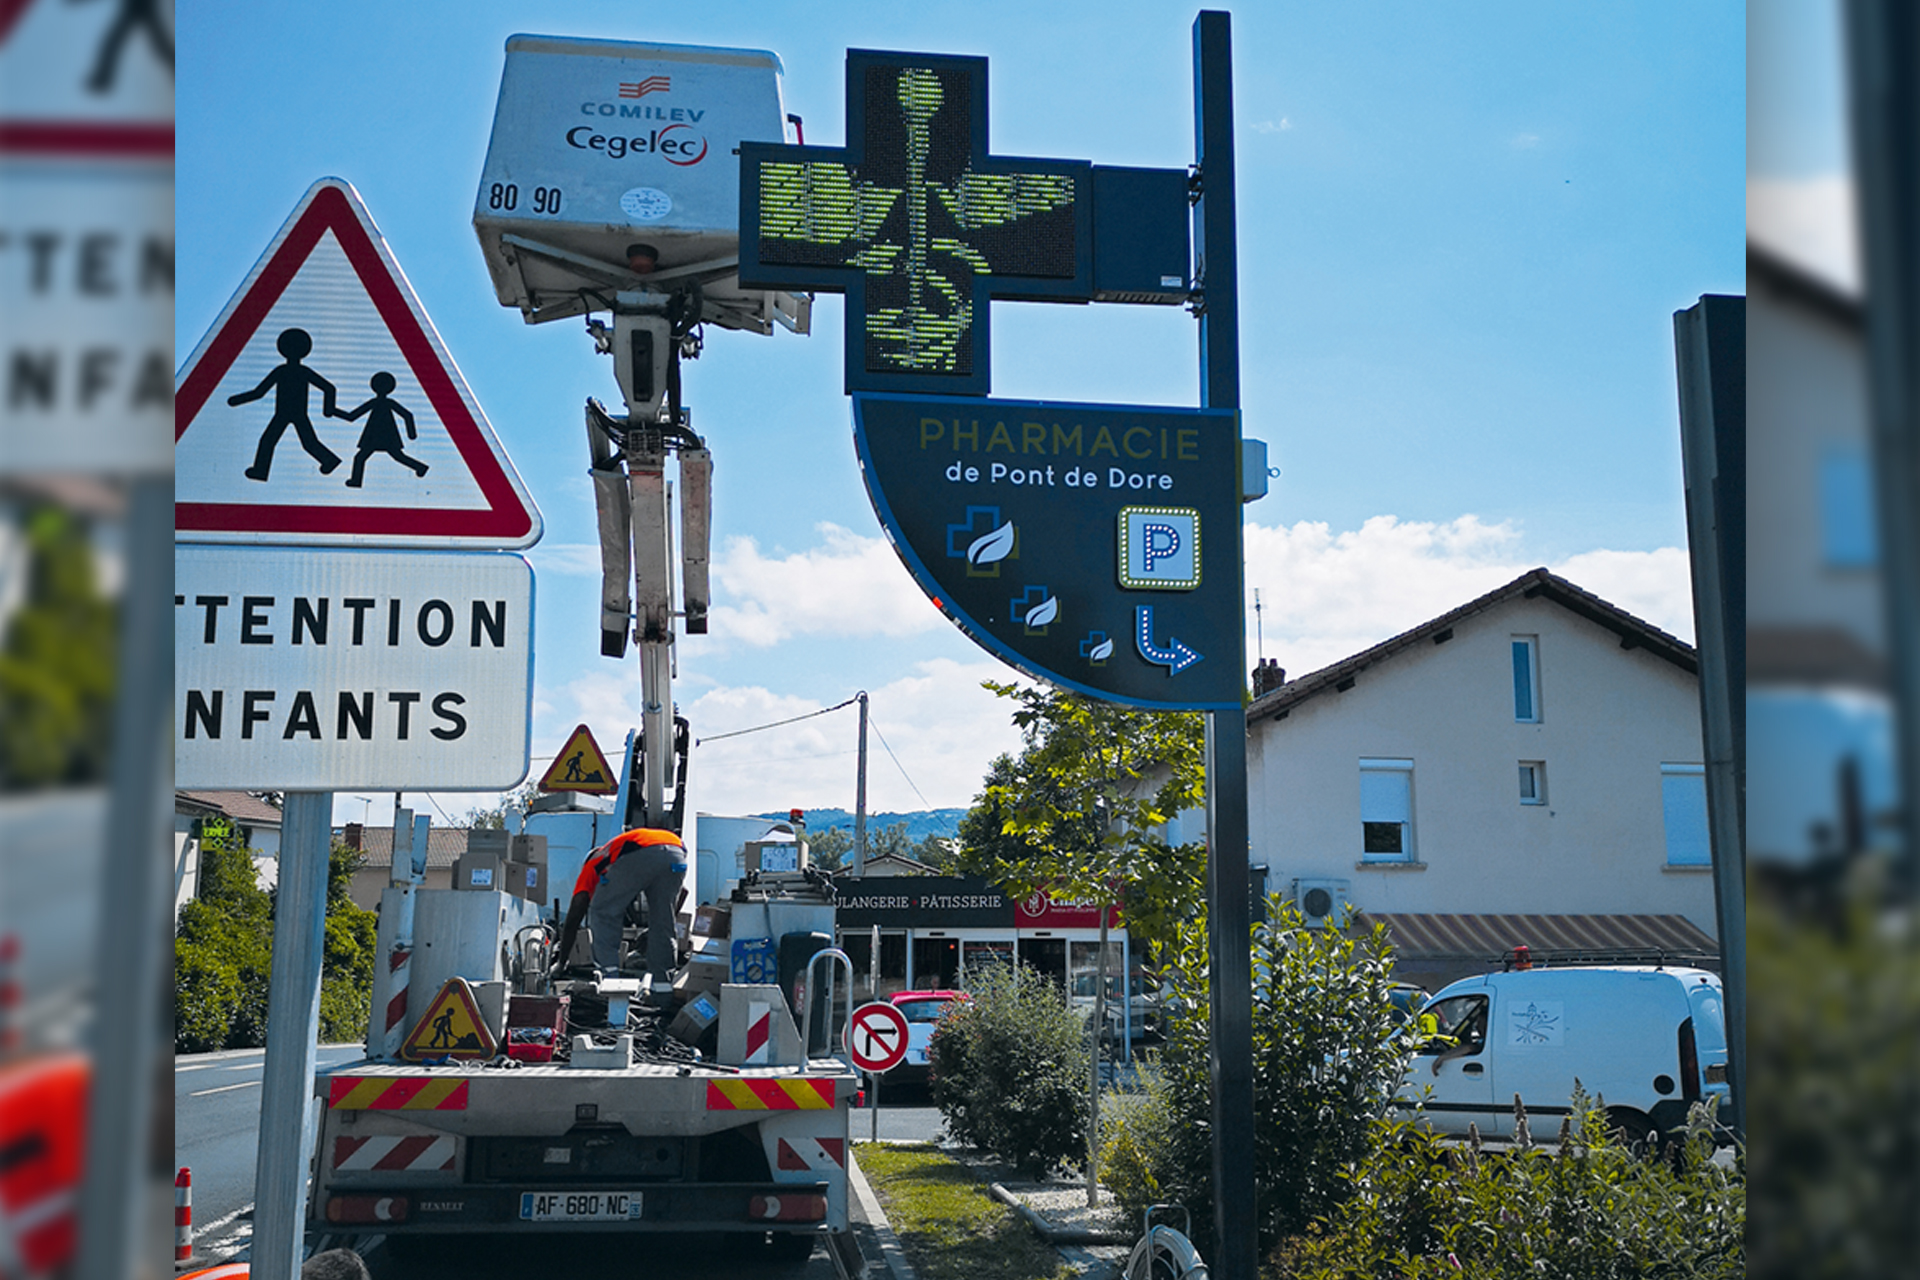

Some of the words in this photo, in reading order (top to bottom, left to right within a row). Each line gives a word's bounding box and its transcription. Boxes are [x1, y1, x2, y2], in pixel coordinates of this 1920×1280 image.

[581, 102, 705, 122] COMILEV
[566, 125, 696, 159] Cegelec
[489, 183, 518, 211] 80
[532, 187, 562, 214] 90
[919, 417, 1200, 461] PHARMACIE
[945, 460, 980, 483] de
[990, 462, 1055, 488] Pont
[1064, 467, 1098, 489] de
[1108, 468, 1174, 491] Dore
[184, 690, 467, 741] NFANTS
[920, 894, 1002, 909] PÂTISSERIE
[536, 1195, 628, 1215] AF-680-NC
